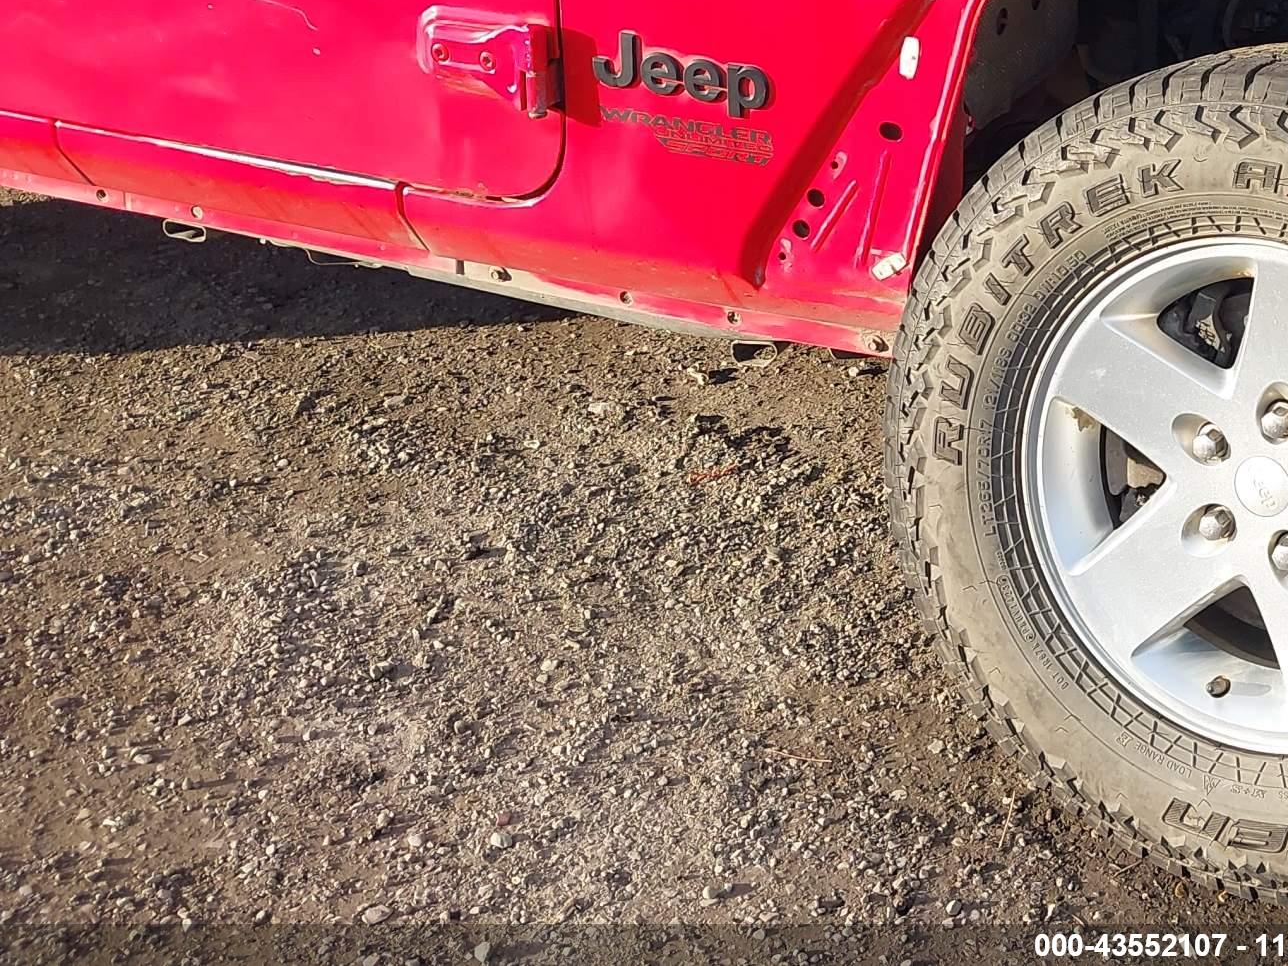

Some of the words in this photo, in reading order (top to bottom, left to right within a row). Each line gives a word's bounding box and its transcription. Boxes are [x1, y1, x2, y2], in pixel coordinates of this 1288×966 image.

[592, 29, 771, 118] Jeep
[600, 106, 773, 145] WRANGLER
[654, 129, 773, 152] UNLIMITED
[662, 141, 774, 166] SPORT
[931, 158, 1185, 466] RUBITREK
[1132, 740, 1165, 765] RANGE
[1165, 756, 1193, 779] LOAD
